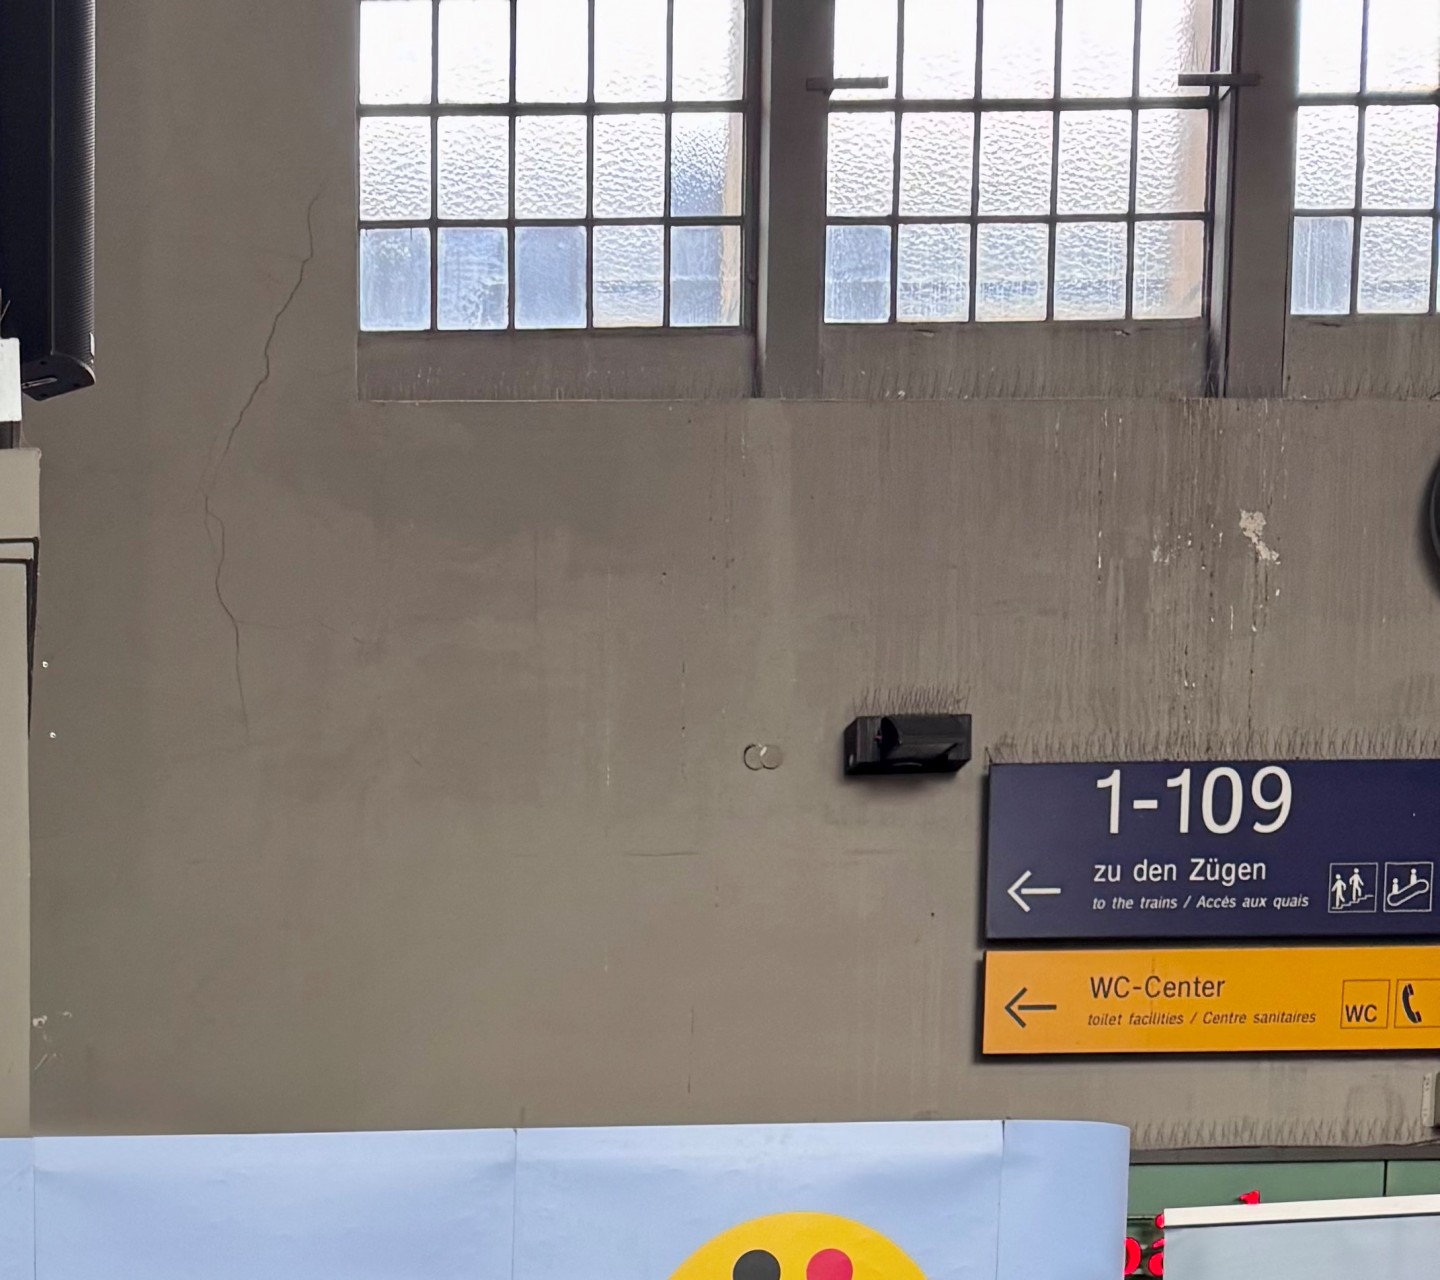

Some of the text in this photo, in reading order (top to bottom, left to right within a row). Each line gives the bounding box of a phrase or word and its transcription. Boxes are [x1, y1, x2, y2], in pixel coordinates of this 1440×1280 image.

[1096, 766, 1293, 835] 1-109
[1093, 858, 1267, 887] zu den Zügen
[1093, 894, 1309, 911] to the trains Accès aux quais
[1089, 975, 1226, 999] WC-Center
[1088, 1009, 1316, 1026] toilet facilities Centre sanitaires
[1345, 1004, 1378, 1023] WC
